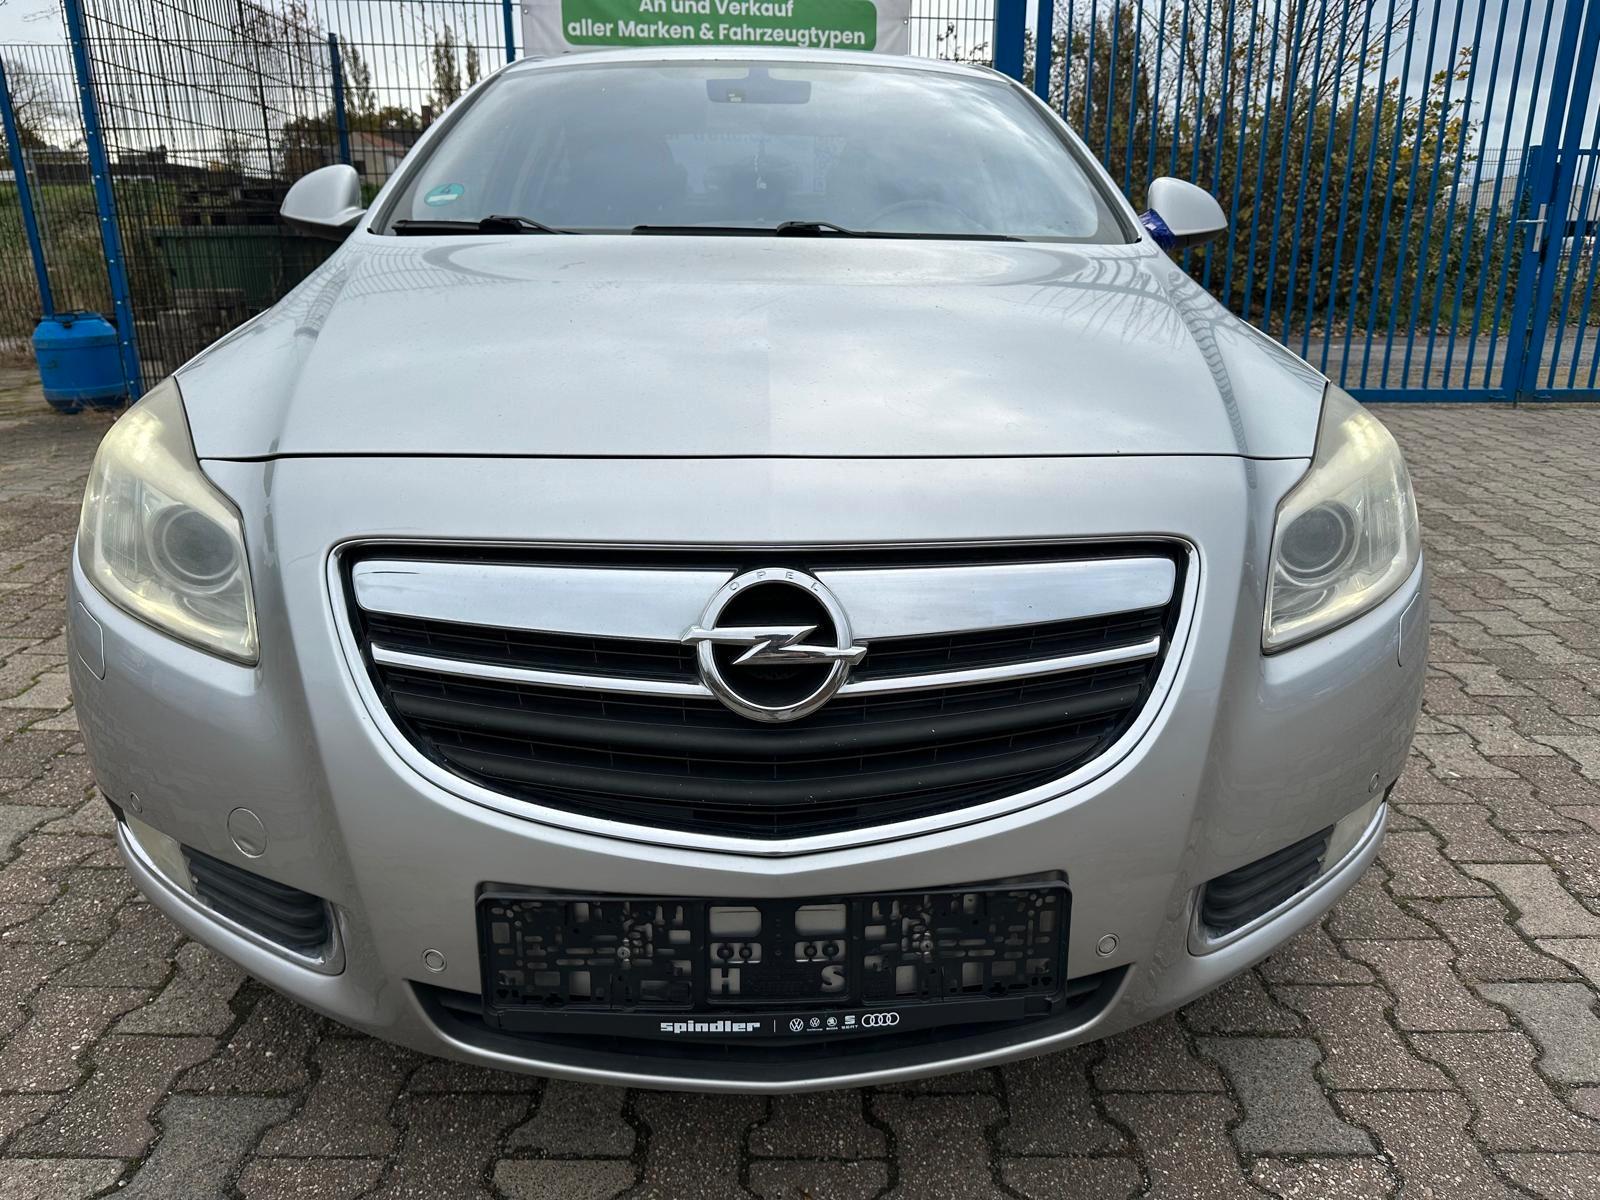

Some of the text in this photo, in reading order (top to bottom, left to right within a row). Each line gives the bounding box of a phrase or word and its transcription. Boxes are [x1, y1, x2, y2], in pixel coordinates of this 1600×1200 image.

[639, 0, 794, 17] An und Verkauf
[567, 18, 866, 48] aller Marken & Fahrzeugtypen
[728, 571, 820, 591] OPEL
[660, 1020, 761, 1034] spindler
